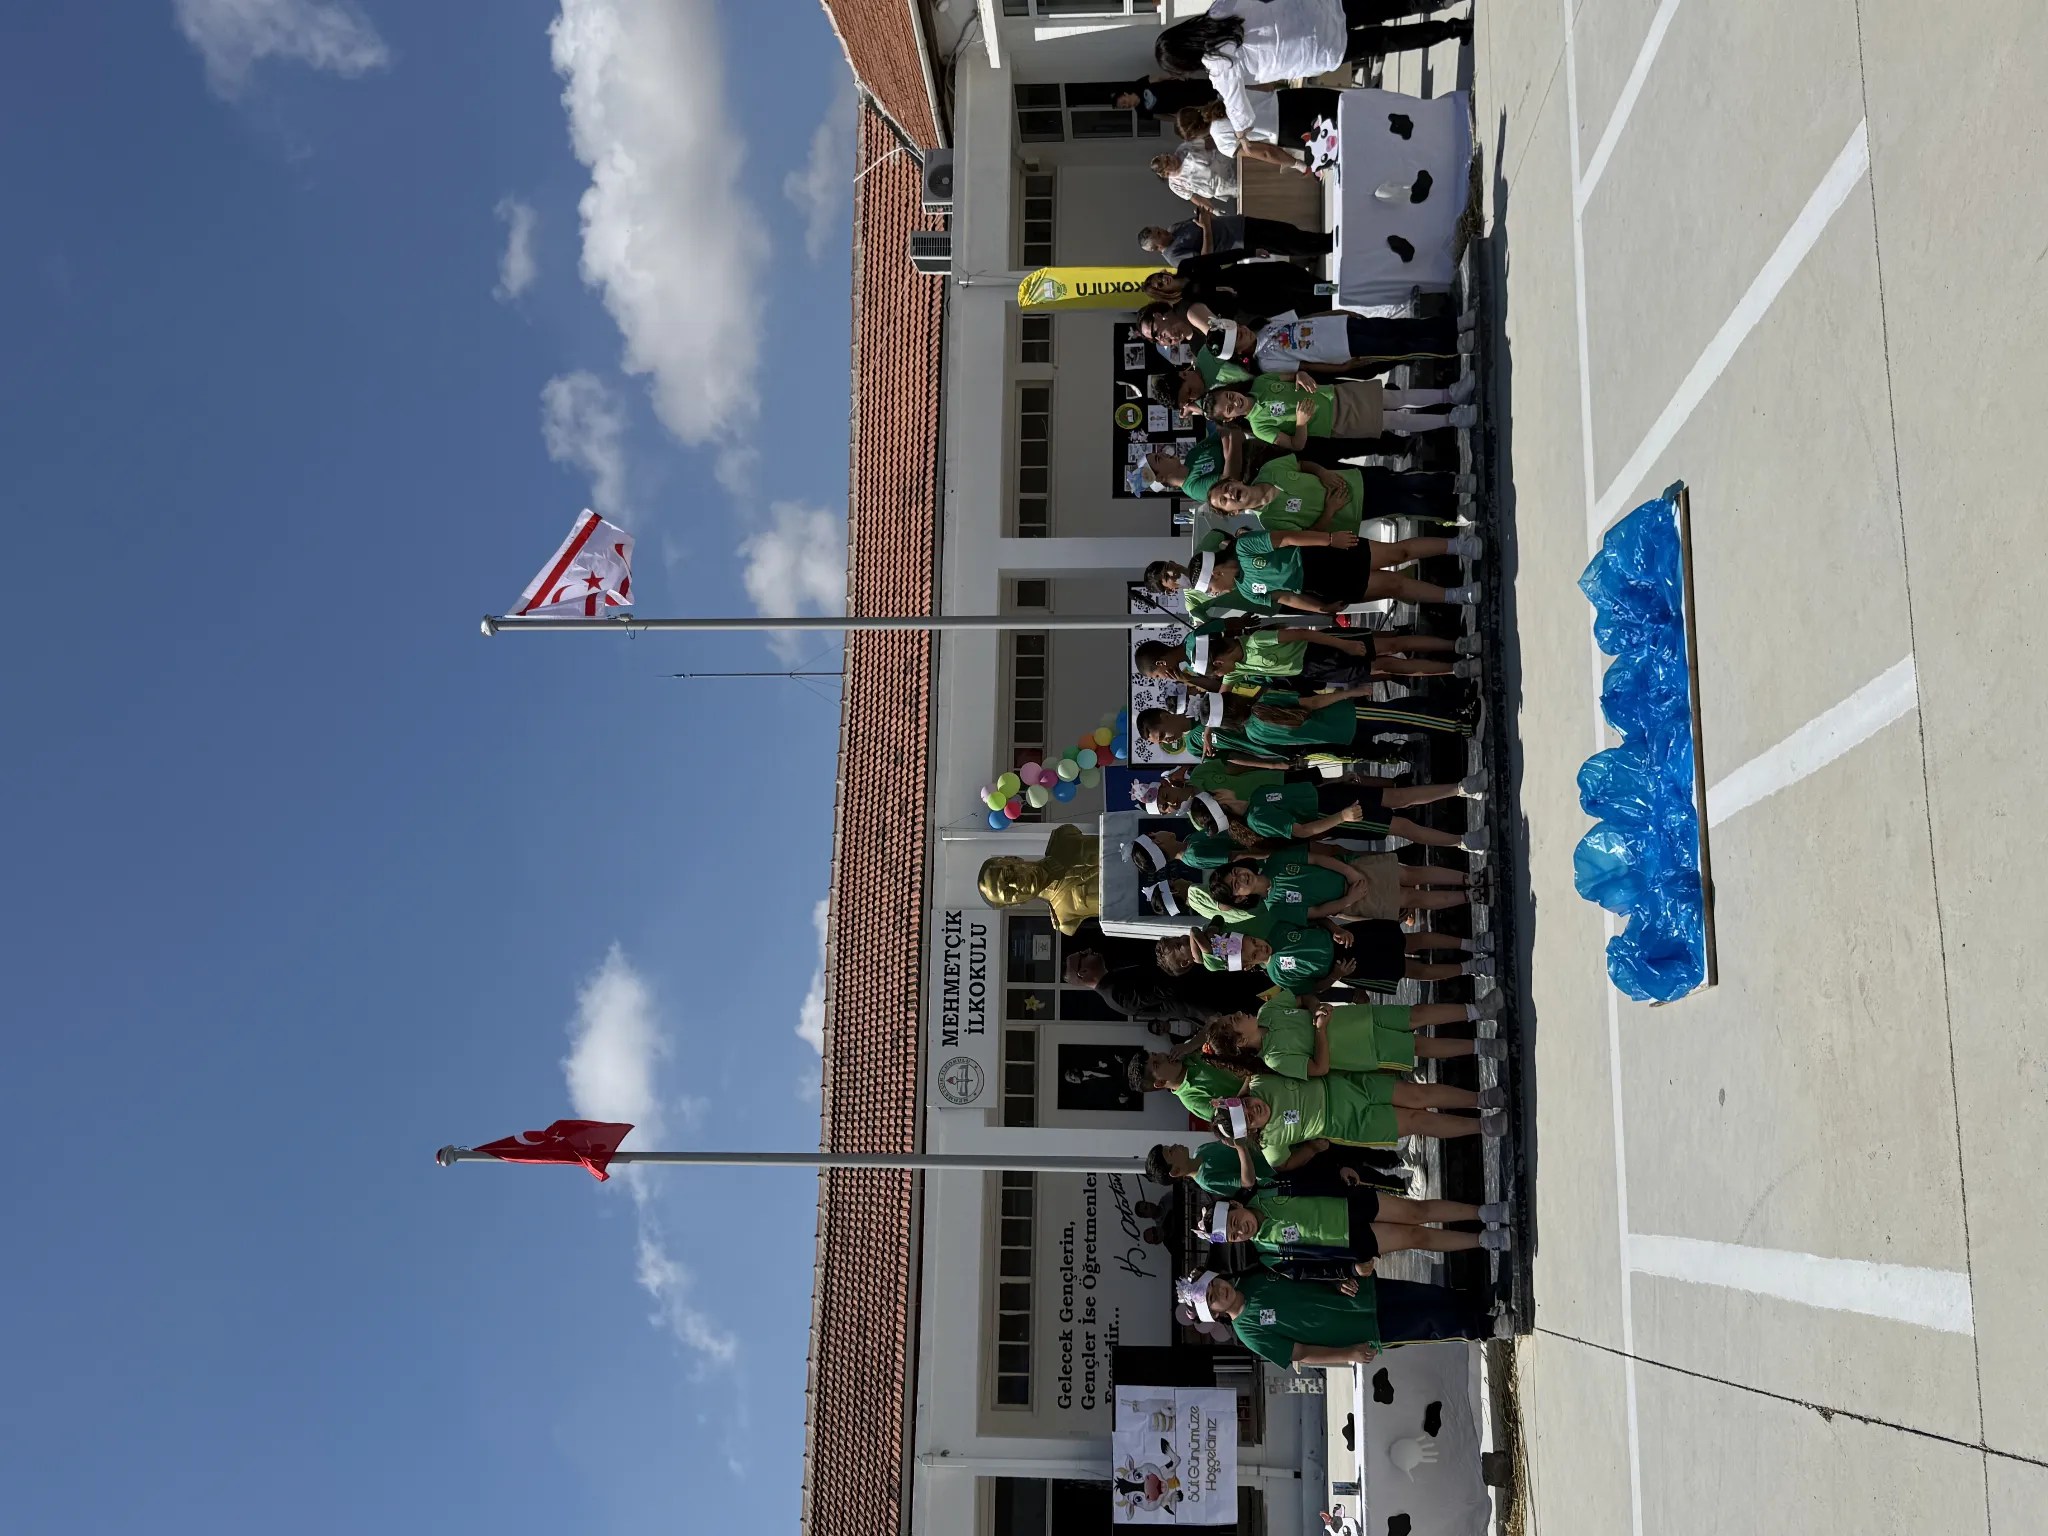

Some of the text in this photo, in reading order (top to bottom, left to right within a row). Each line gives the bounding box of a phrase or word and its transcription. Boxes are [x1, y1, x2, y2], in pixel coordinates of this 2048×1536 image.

[1076, 282, 1145, 296] KOKULU
[941, 910, 965, 1047] MEHMETÇİK
[964, 923, 987, 1035] İLKOKULU
[1058, 1221, 1077, 1409] Gelecek Gençlerin,
[1078, 1172, 1100, 1410] Gençler İse Öğretmenler
[1188, 1405, 1200, 1502] Süt Günümüze
[1205, 1418, 1221, 1491] Hoşgeldiniz
